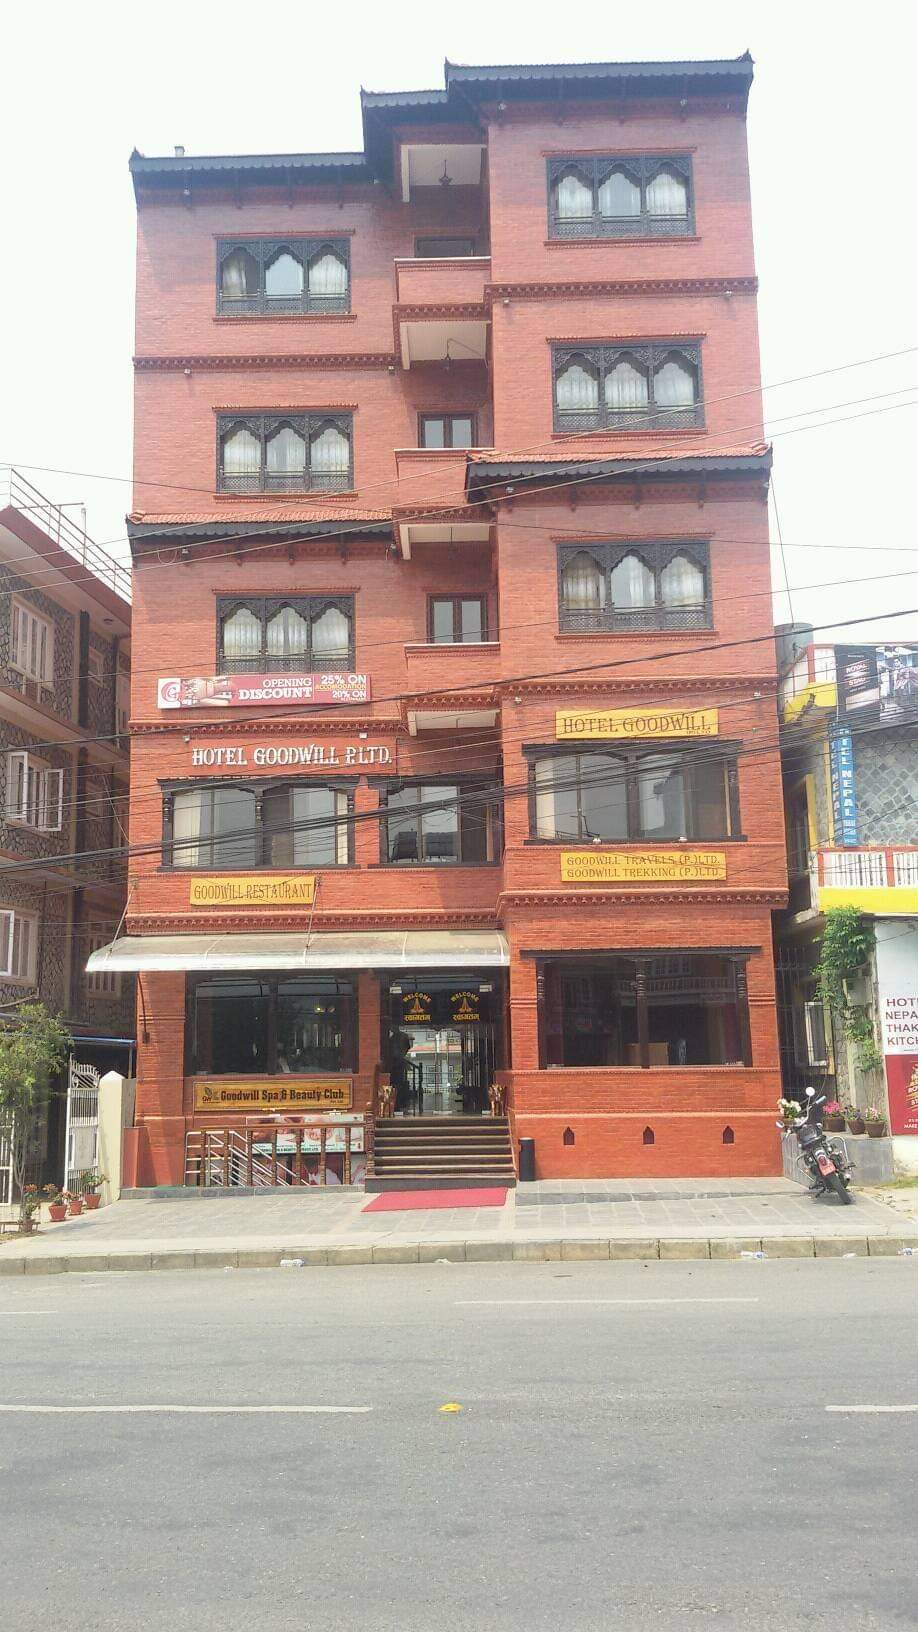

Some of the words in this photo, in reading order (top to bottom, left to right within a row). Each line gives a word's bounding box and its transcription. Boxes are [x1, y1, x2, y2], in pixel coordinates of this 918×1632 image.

[262, 678, 312, 689] OPENING
[321, 675, 345, 685] 25%
[347, 674, 367, 684] ON
[238, 687, 313, 700] DISCOUNT
[332, 690, 350, 698] 20%
[352, 690, 367, 698] ON
[563, 718, 618, 734] HOTEL
[622, 713, 711, 732] GOODWILL
[192, 747, 248, 766] HOTEL
[253, 743, 339, 766] GOODWILL
[842, 770, 854, 817] NEPAL
[567, 855, 621, 866] GOODWILL
[625, 855, 675, 866] TRAVELS
[567, 867, 621, 878] GOODWILL
[624, 867, 676, 877] TREKKING
[194, 882, 243, 900] GOODWILL
[246, 883, 312, 899] RESTAURANT
[403, 992, 432, 1003] WELCOME
[450, 991, 480, 1003] WELCOME
[886, 998, 918, 1007] HOT
[885, 1011, 918, 1020] NEPA
[886, 1023, 918, 1032] THAK
[220, 1089, 259, 1101] Goodwill
[262, 1090, 279, 1102] Spa
[289, 1089, 321, 1102] Beauty
[324, 1088, 344, 1100] Club
